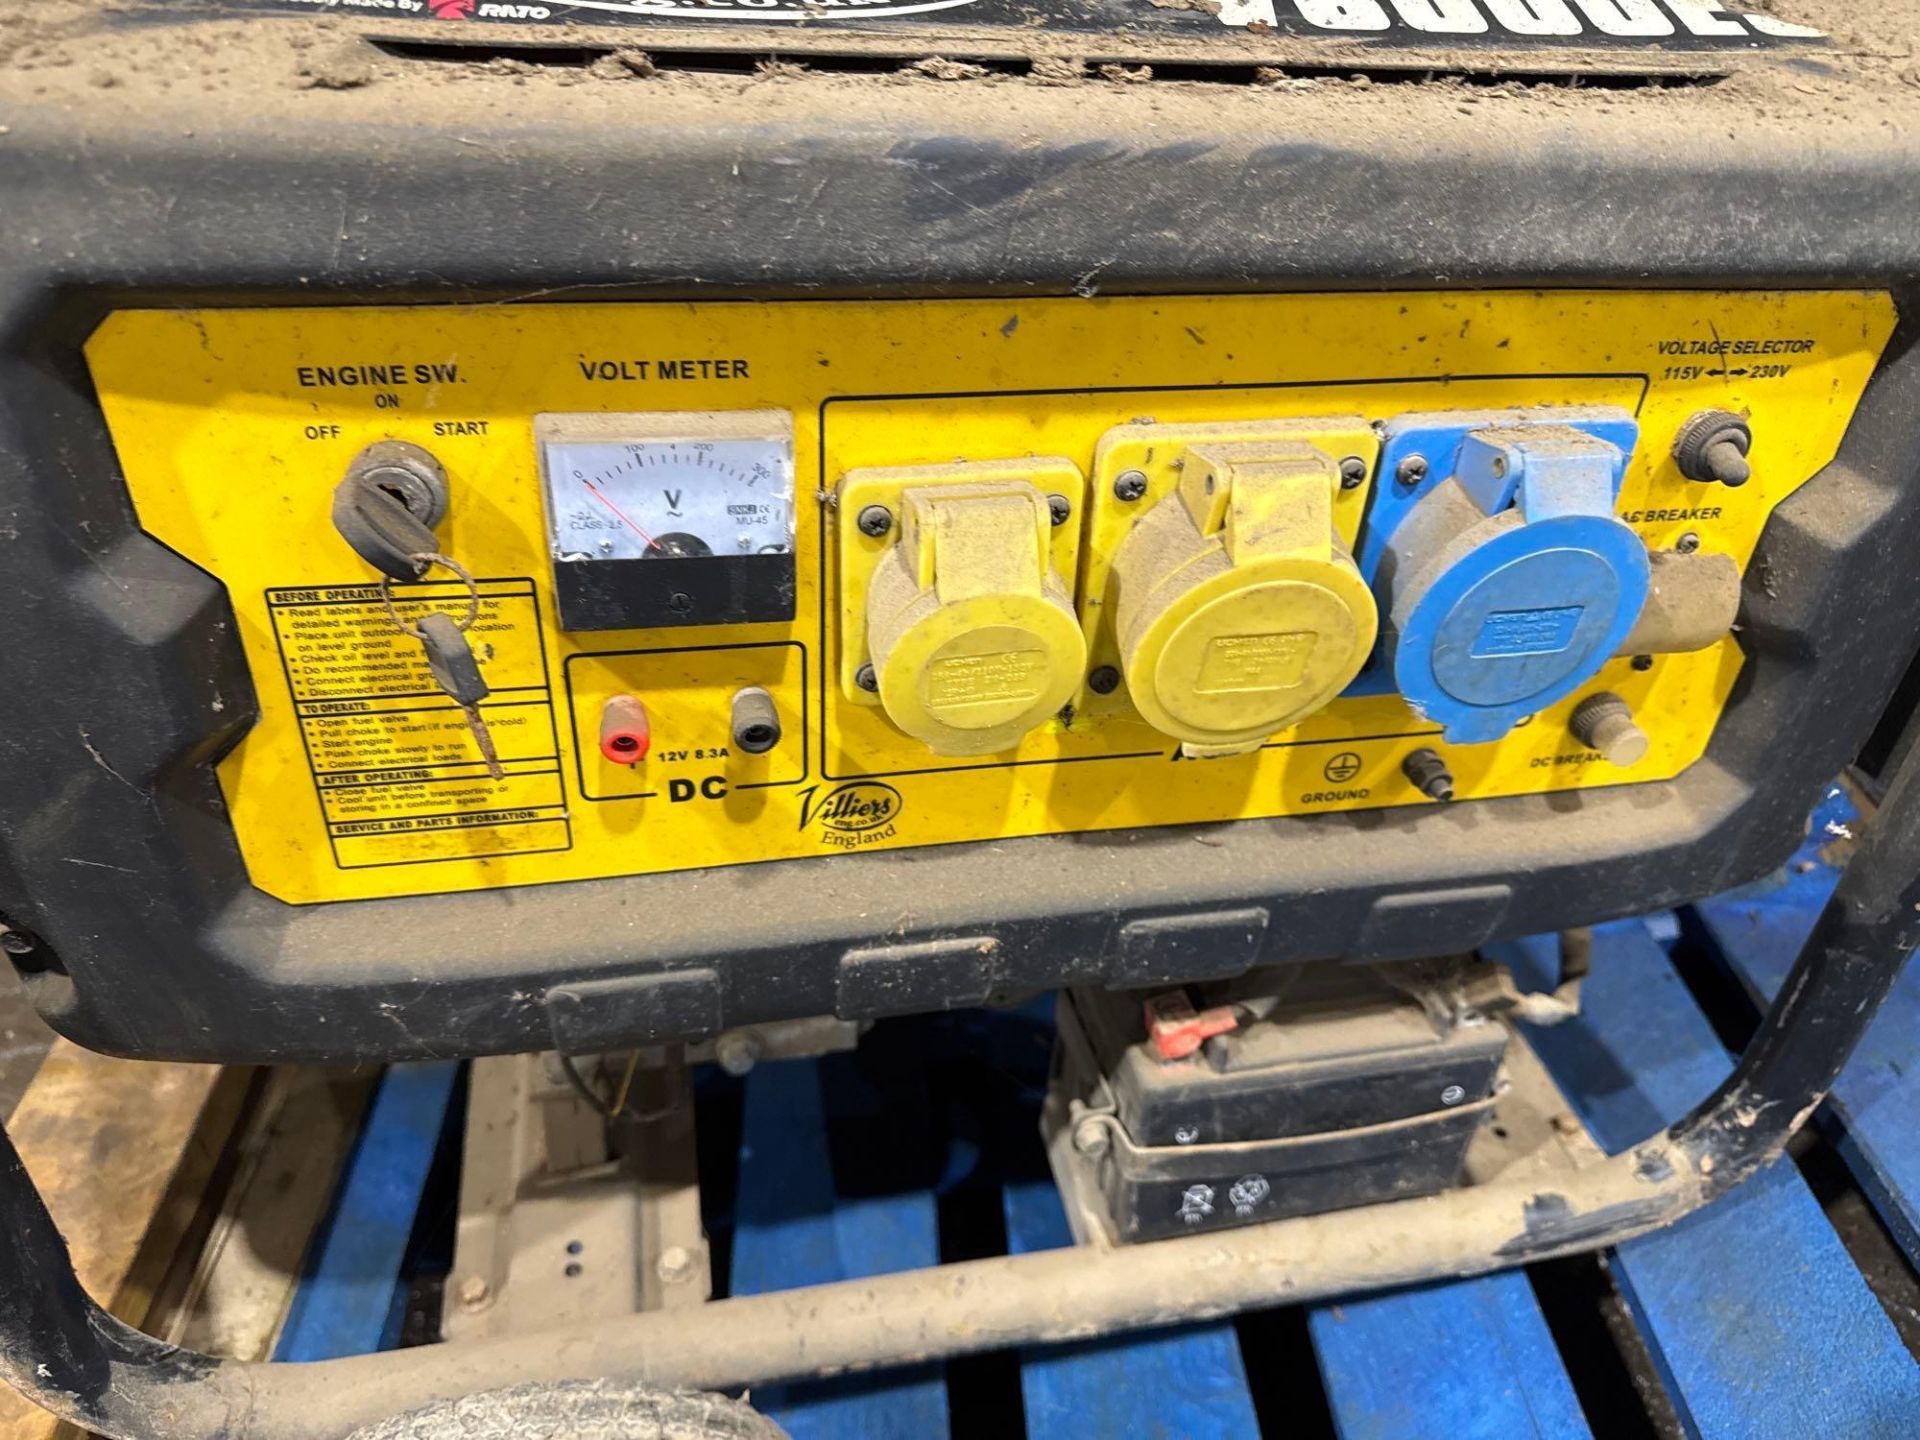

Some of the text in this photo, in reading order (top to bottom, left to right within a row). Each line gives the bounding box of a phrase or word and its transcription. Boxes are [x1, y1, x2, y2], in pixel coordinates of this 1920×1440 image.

[478, 3, 550, 20] RATO
[1658, 340, 1814, 355] VOLTAGE SELECTOR
[297, 364, 467, 386] ENGINE SW.
[580, 359, 750, 380] VOLT METER
[1664, 365, 1791, 380] 115V 230V
[375, 393, 400, 409] ON
[305, 425, 341, 440] OFF
[434, 421, 489, 436] START
[625, 443, 645, 453] 100
[664, 490, 682, 509] V
[1644, 507, 1722, 522] BREAKER
[275, 591, 321, 601] BEFORE
[292, 619, 340, 629] detailed
[295, 632, 329, 640] Place
[298, 644, 313, 652] on
[351, 640, 392, 651] ground
[301, 655, 337, 663] Check
[304, 666, 321, 675] Do
[325, 661, 408, 673] recommended
[307, 676, 356, 686] Connect
[359, 672, 412, 682] electrical
[309, 686, 374, 696] Disconnect
[378, 682, 431, 692] electrical
[304, 704, 320, 714] TO
[317, 718, 348, 728] Open
[346, 727, 381, 736] choke
[323, 737, 394, 749] Start engine
[325, 750, 354, 758] Push
[357, 748, 391, 757] choke
[658, 747, 730, 763] 12V 8.3A
[328, 759, 375, 769] Connect
[1529, 756, 1550, 768] DC
[323, 774, 359, 784] AFTER
[335, 788, 367, 796] Close
[669, 775, 729, 803] DC
[1301, 788, 1370, 804] GROUND
[796, 784, 892, 832] Villiers
[335, 824, 385, 834] SERVICE
[389, 821, 413, 831] AND
[416, 817, 453, 828] PARTS
[820, 824, 897, 850] England
